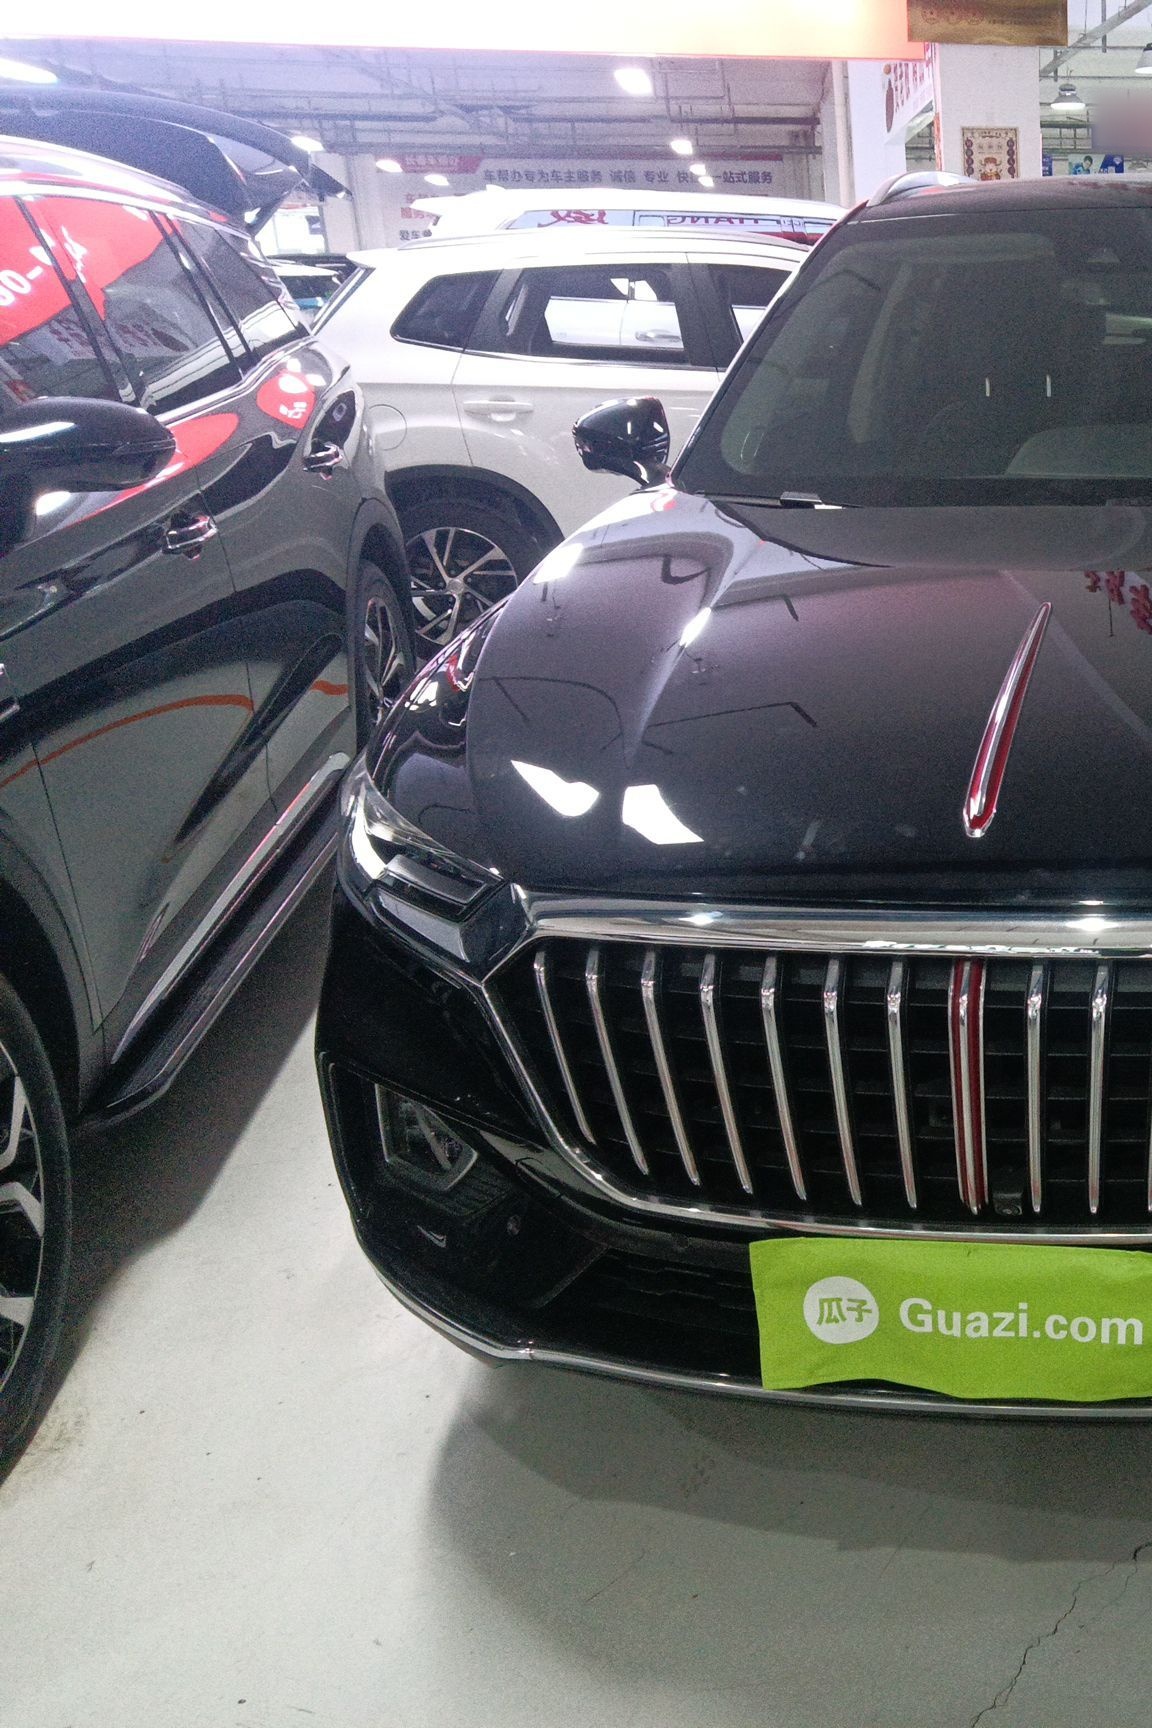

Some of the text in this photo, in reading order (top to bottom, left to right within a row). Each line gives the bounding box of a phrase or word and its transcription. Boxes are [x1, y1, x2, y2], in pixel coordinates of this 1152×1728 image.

[643, 170, 669, 184] 专业
[816, 1297, 1144, 1345] 瓜子 Guazi.com
